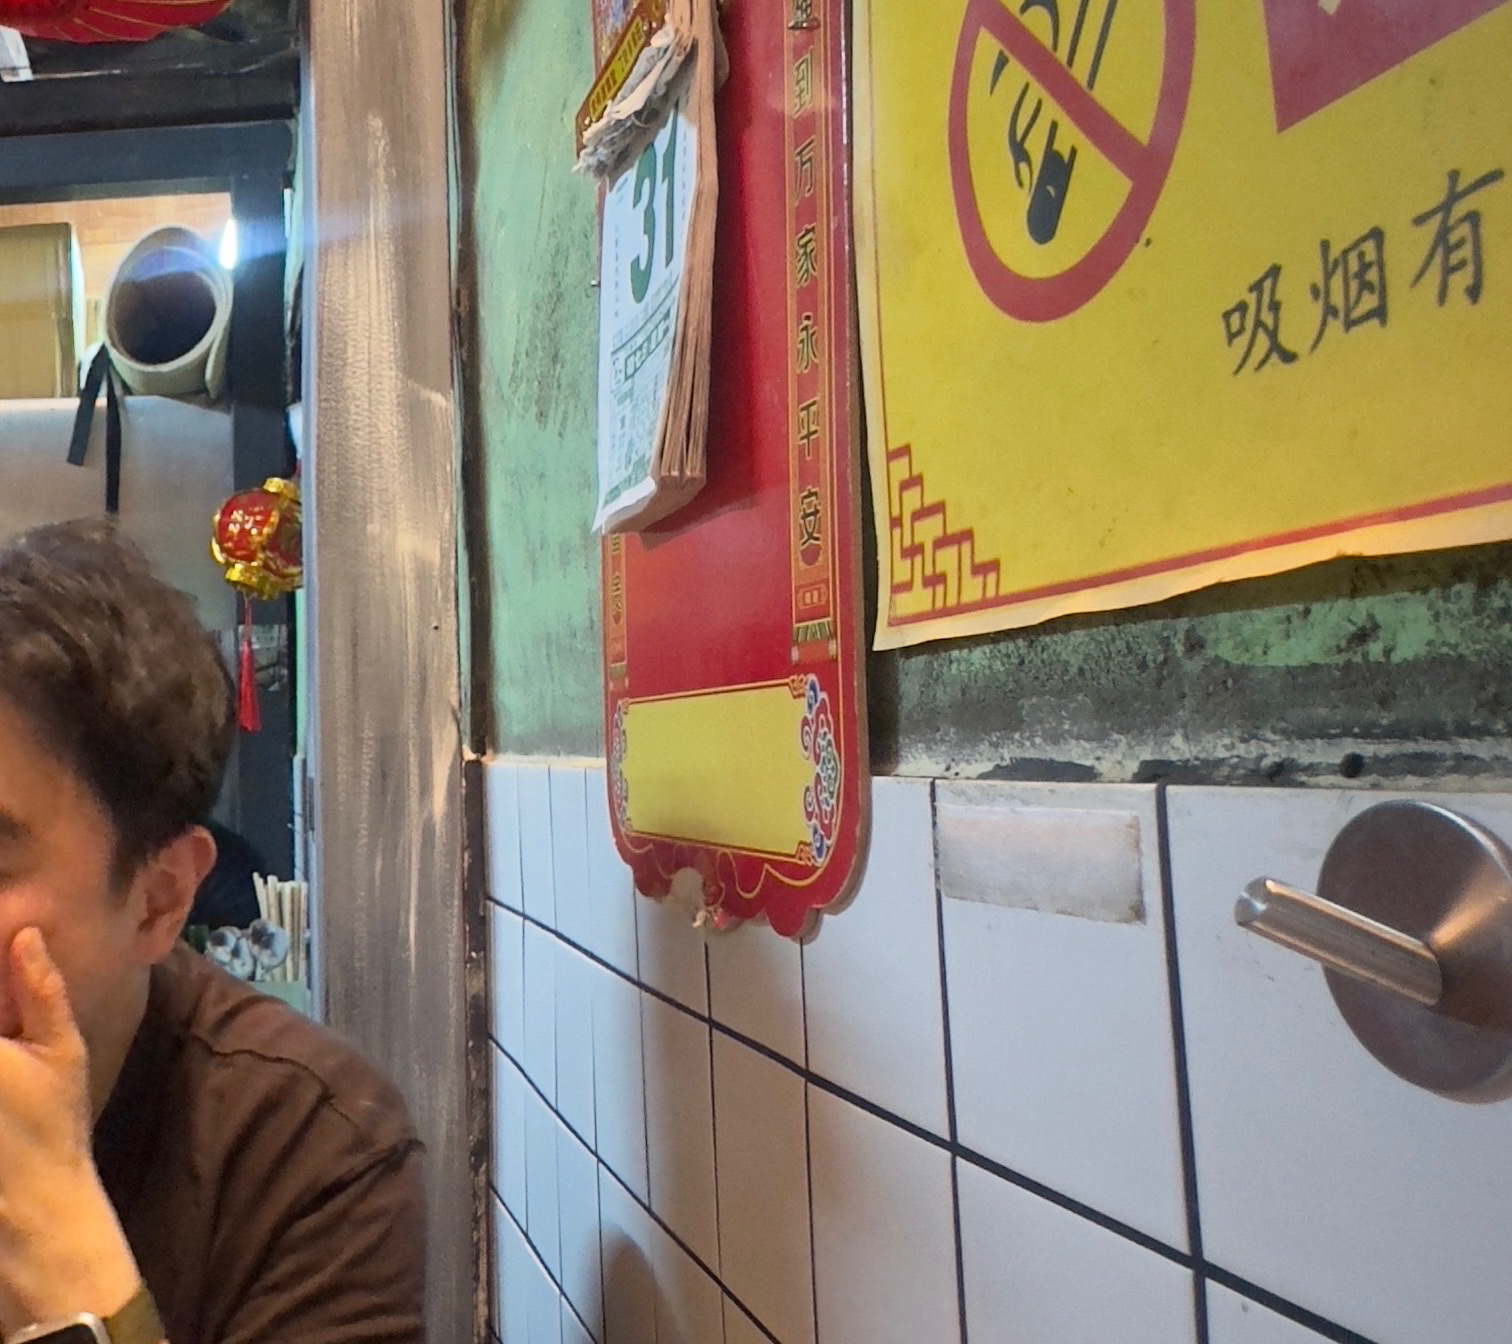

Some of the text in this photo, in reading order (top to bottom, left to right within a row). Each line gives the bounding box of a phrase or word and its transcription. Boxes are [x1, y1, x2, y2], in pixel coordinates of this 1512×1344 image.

[630, 98, 679, 304] 31
[1222, 168, 1504, 376] 吸烟有
